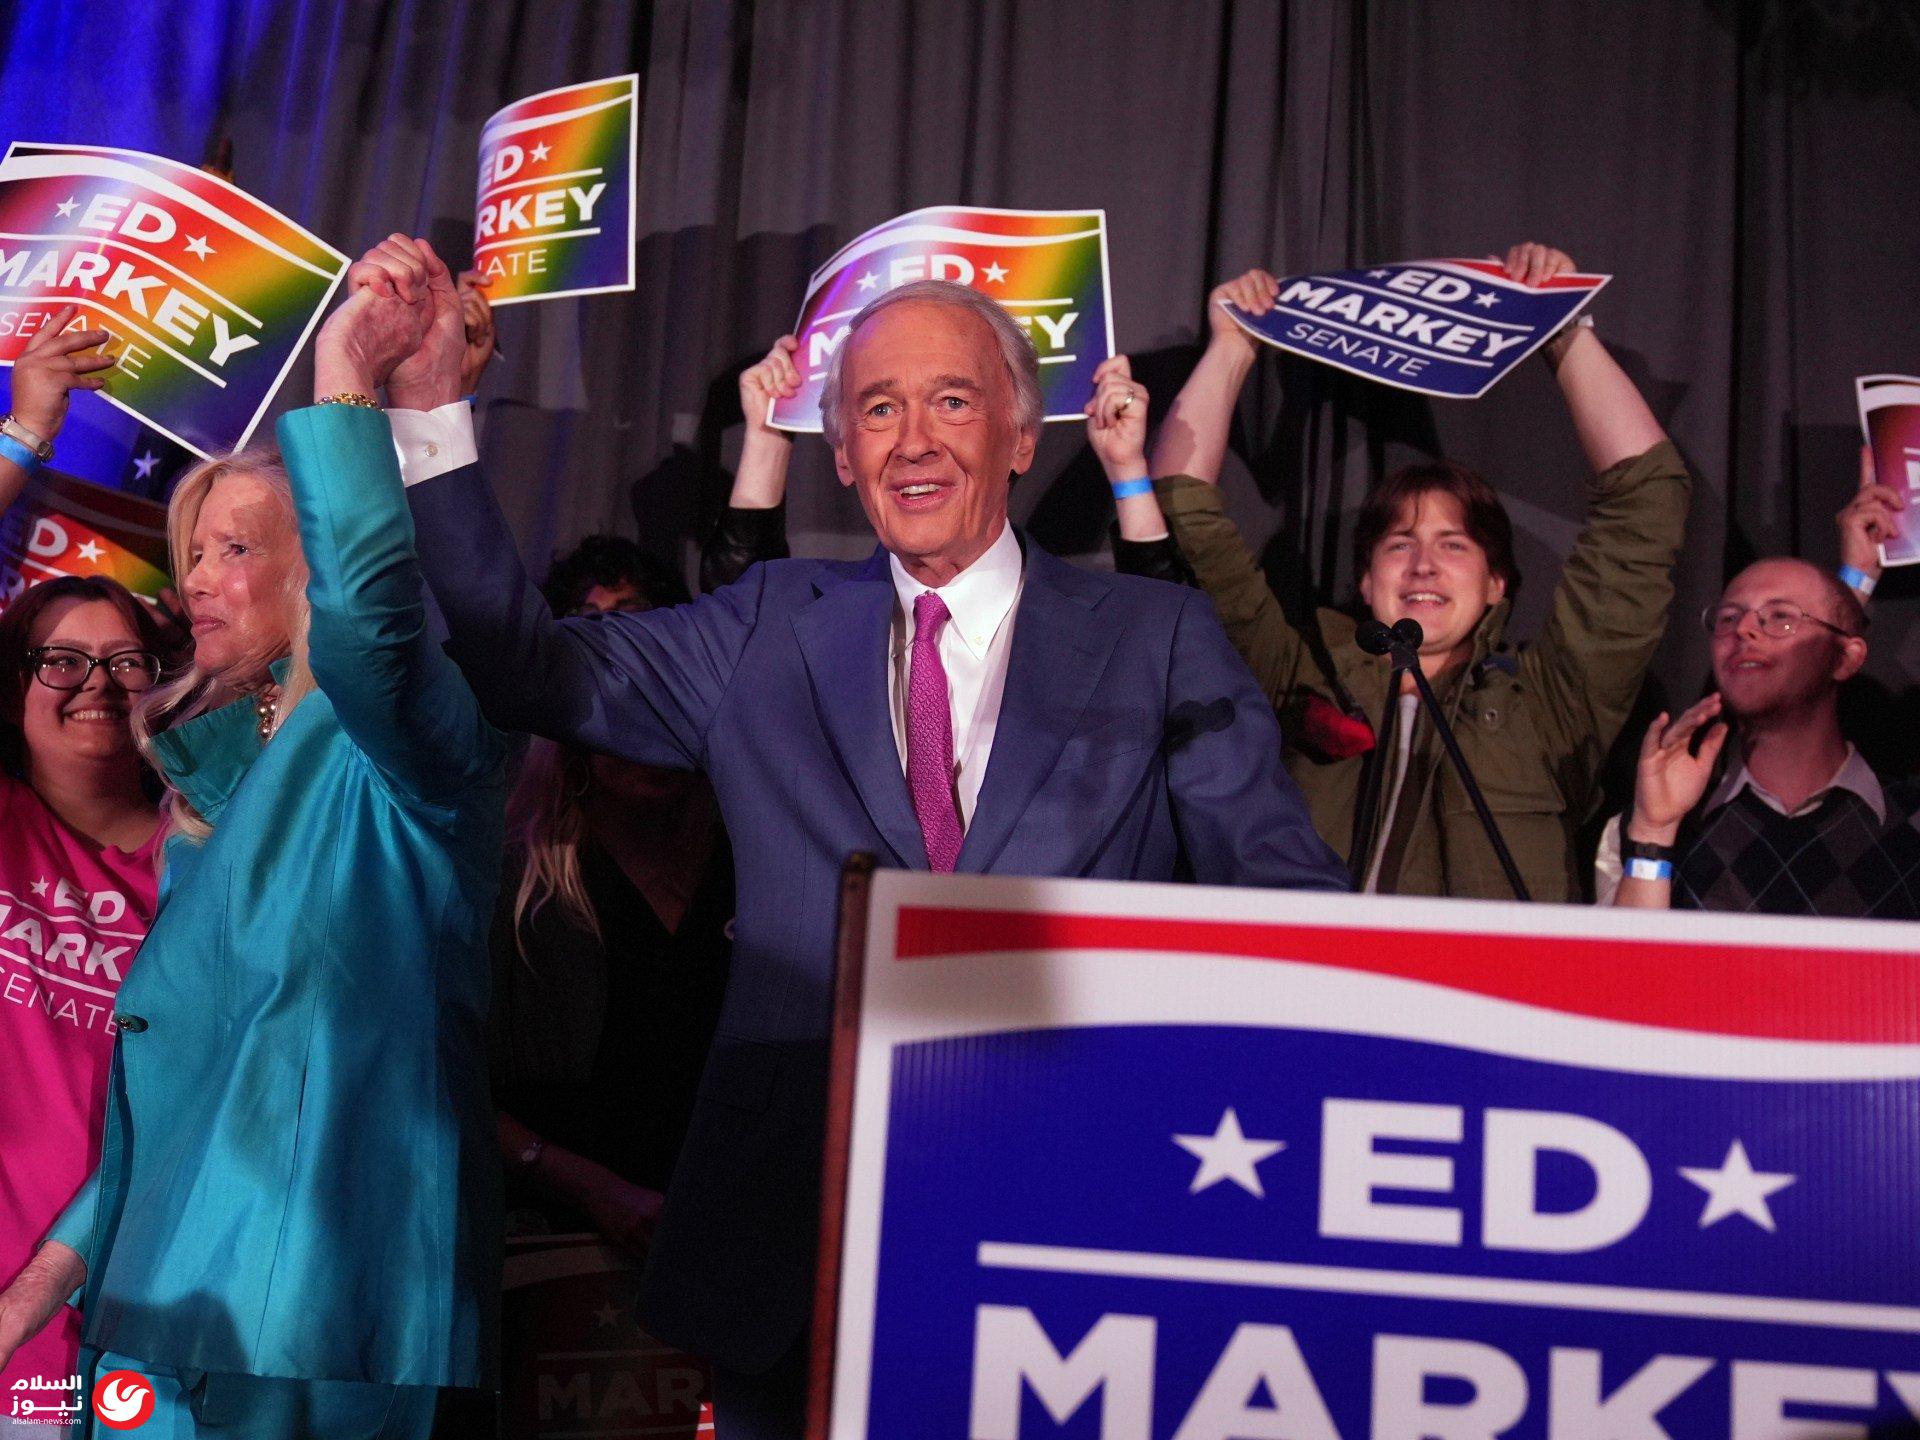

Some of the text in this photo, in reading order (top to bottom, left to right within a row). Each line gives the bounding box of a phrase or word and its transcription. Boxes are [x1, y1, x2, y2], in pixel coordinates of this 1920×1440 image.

[79, 193, 177, 243] ED
[476, 183, 607, 243] RKEY
[478, 249, 548, 277] ATE
[1386, 268, 1472, 302] ED
[1279, 281, 1529, 358] MARKEY
[1285, 322, 1430, 377] SENATE
[28, 517, 69, 557] D
[53, 876, 126, 924] ED
[0, 903, 132, 982] ARK
[0, 966, 118, 1036] ENATE
[1318, 1097, 1652, 1255] ED
[538, 1367, 708, 1420] MAR
[968, 1303, 1920, 1440] MARKE
